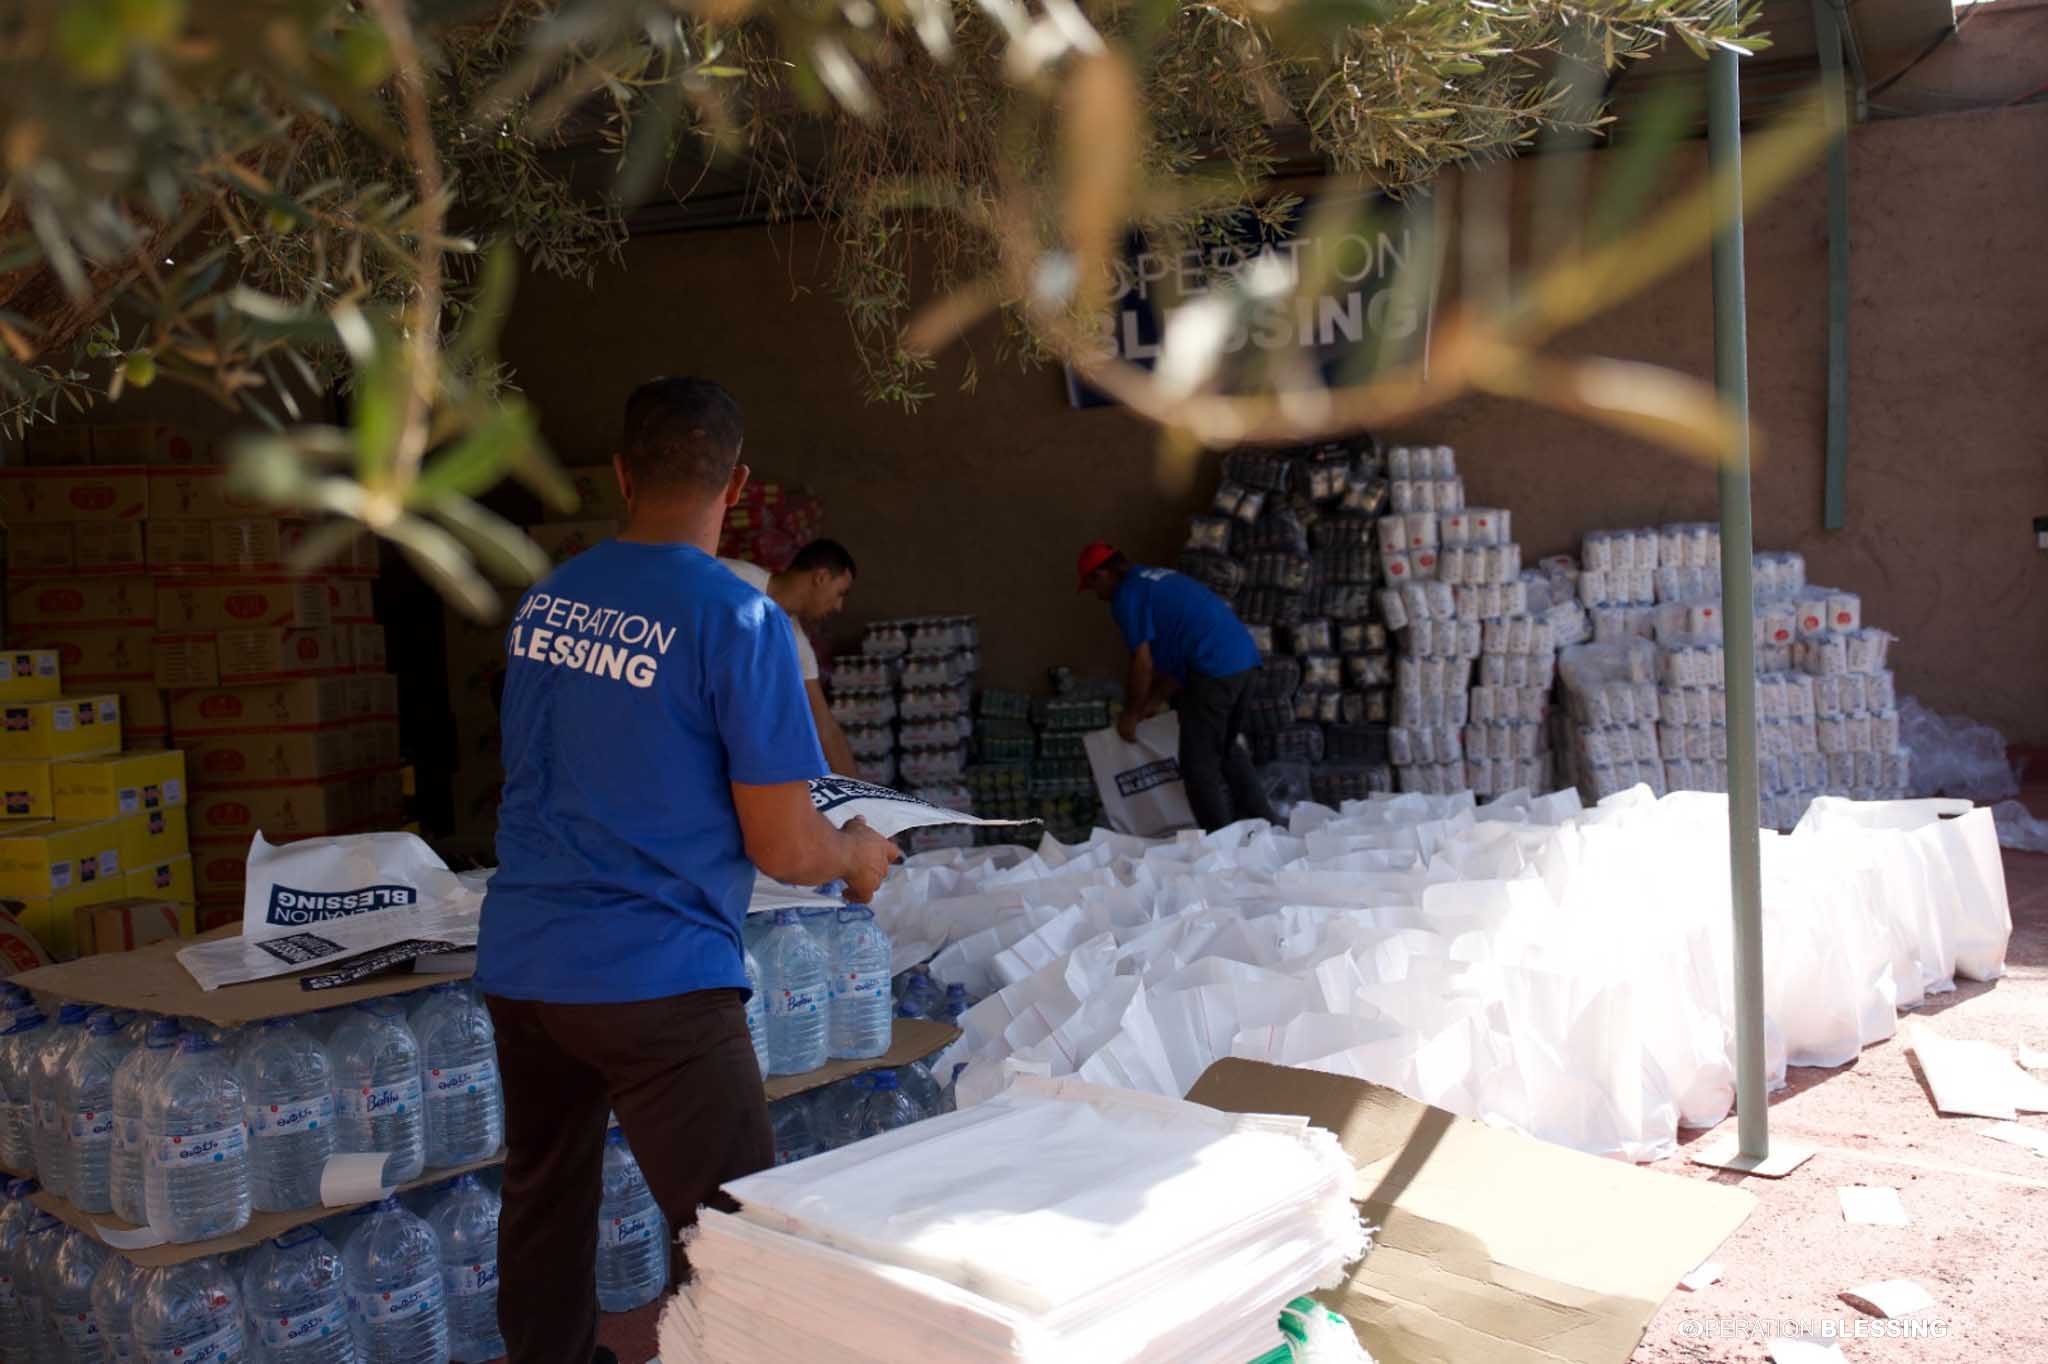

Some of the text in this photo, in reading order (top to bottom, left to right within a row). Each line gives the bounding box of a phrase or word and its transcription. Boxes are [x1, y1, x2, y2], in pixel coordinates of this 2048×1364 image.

[1088, 287, 1419, 361] BLSING
[509, 624, 658, 689] LESSING
[276, 888, 409, 909] BLESSING
